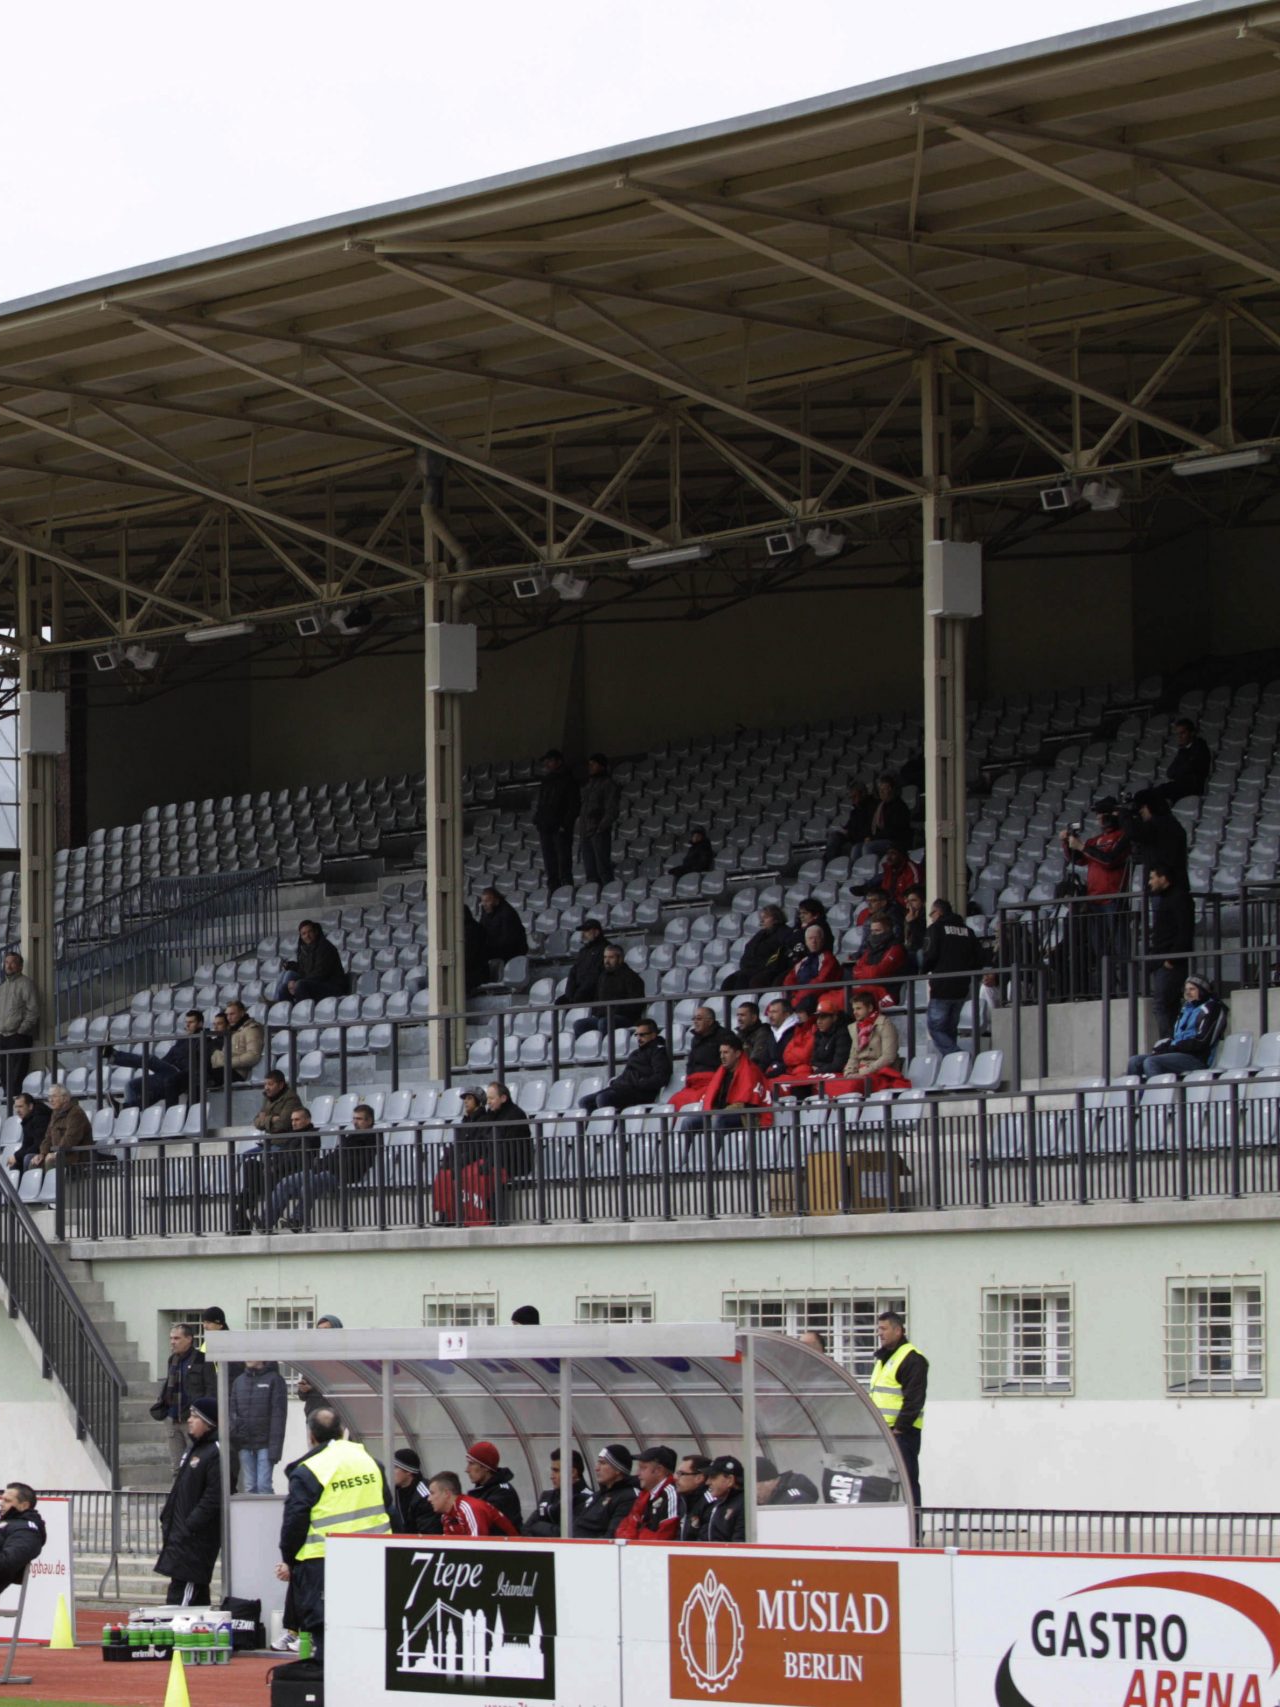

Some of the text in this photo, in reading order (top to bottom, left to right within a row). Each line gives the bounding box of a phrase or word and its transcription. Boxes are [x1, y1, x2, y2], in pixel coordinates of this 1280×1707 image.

[331, 1473, 376, 1492] PRESSE
[491, 1571, 539, 1597] Istanbul
[756, 1579, 889, 1634] MÜSIAD
[1031, 1609, 1188, 1662] GASTRO
[784, 1651, 863, 1682] BERLIN
[1123, 1669, 1263, 1707] ARENA
